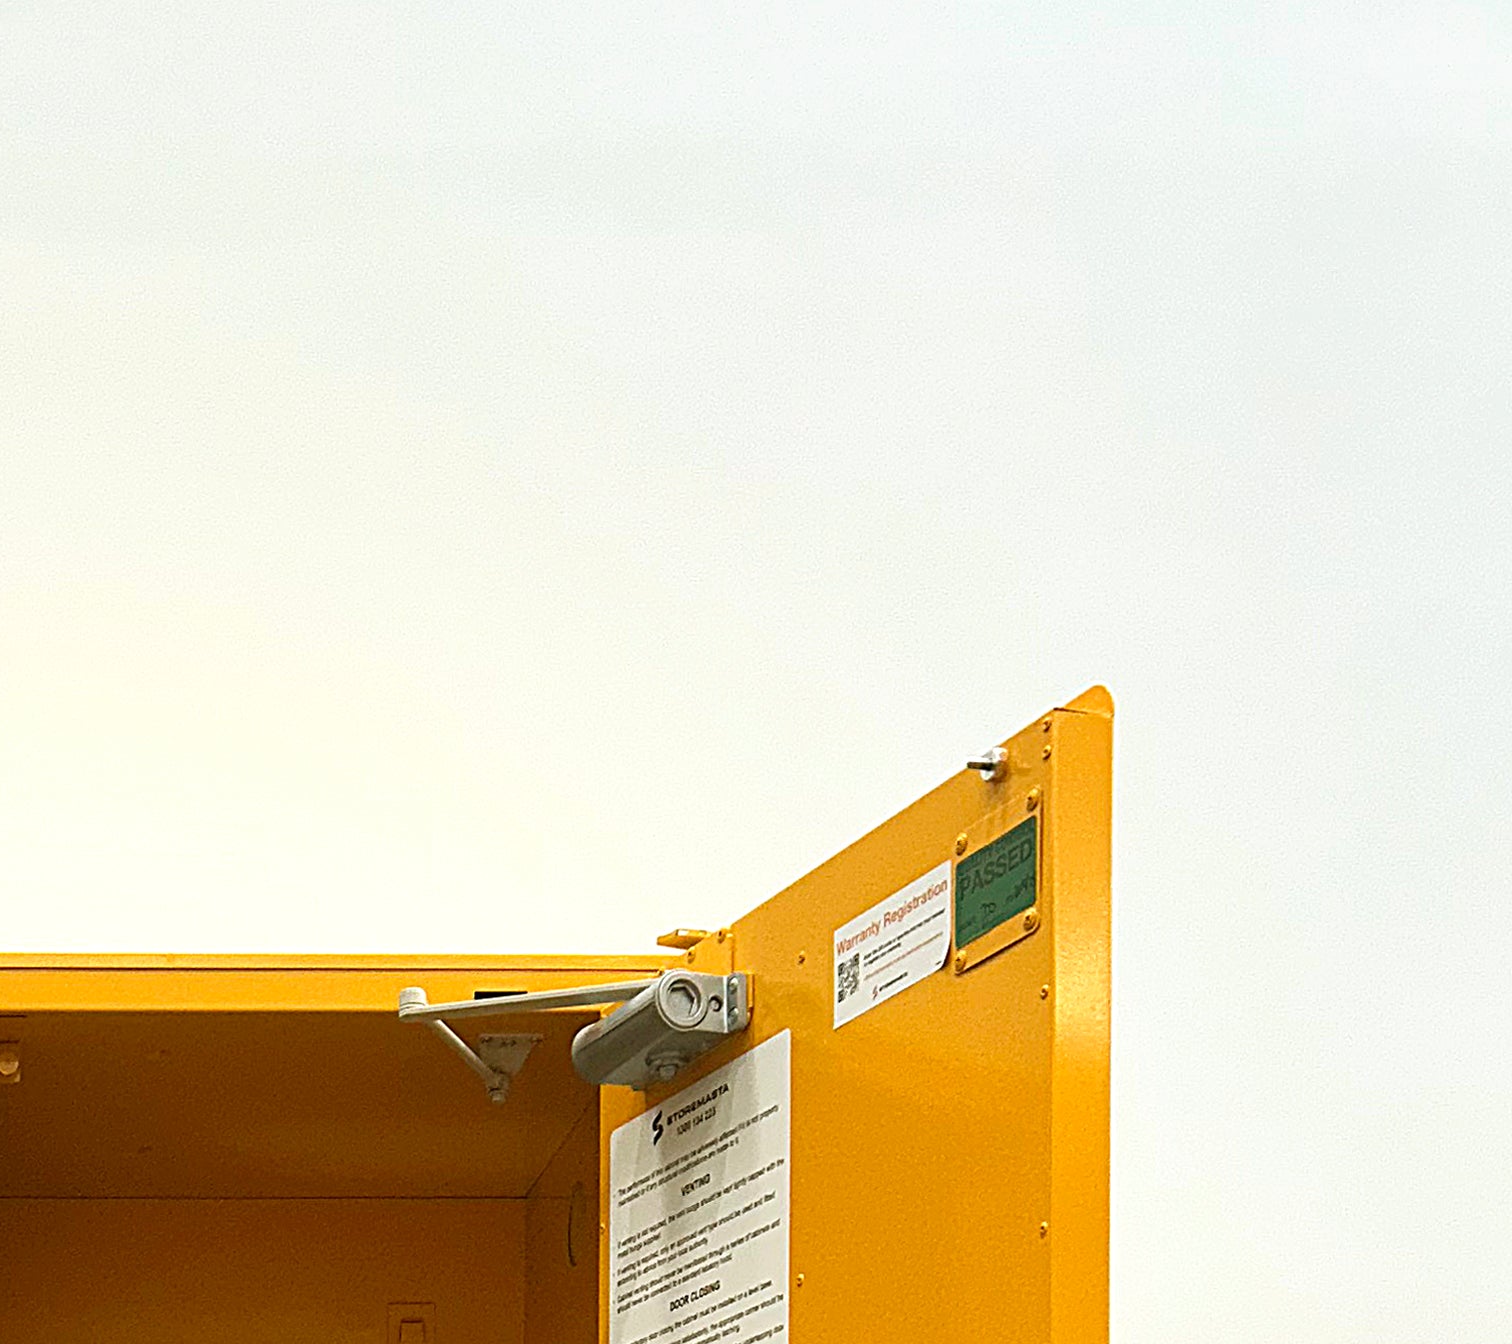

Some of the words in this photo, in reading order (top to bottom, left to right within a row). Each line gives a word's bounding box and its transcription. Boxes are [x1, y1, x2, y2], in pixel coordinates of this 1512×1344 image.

[960, 838, 1032, 902] PASSED
[837, 921, 881, 956] Warranty
[884, 880, 947, 927] Registration
[667, 1084, 728, 1126] STOREMASTA
[670, 1295, 689, 1311] DOOR
[691, 1280, 720, 1302] CLOSING
